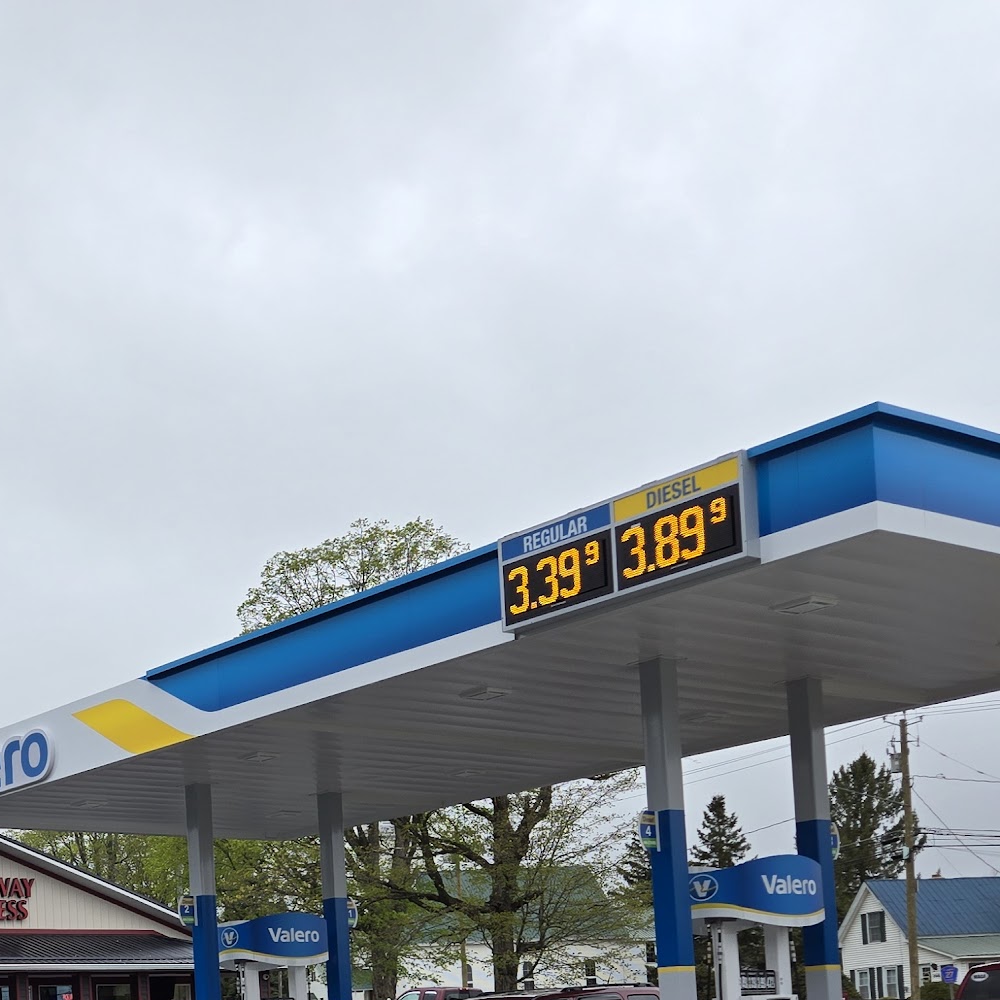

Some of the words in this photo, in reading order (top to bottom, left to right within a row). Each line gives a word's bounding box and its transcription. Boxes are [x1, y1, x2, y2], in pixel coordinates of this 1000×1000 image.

[646, 475, 702, 510] DIESEL
[523, 515, 588, 553] REGULAR
[645, 825, 652, 837] 4
[760, 874, 817, 896] Valero
[184, 905, 190, 914] 2
[267, 926, 321, 943] Valero
